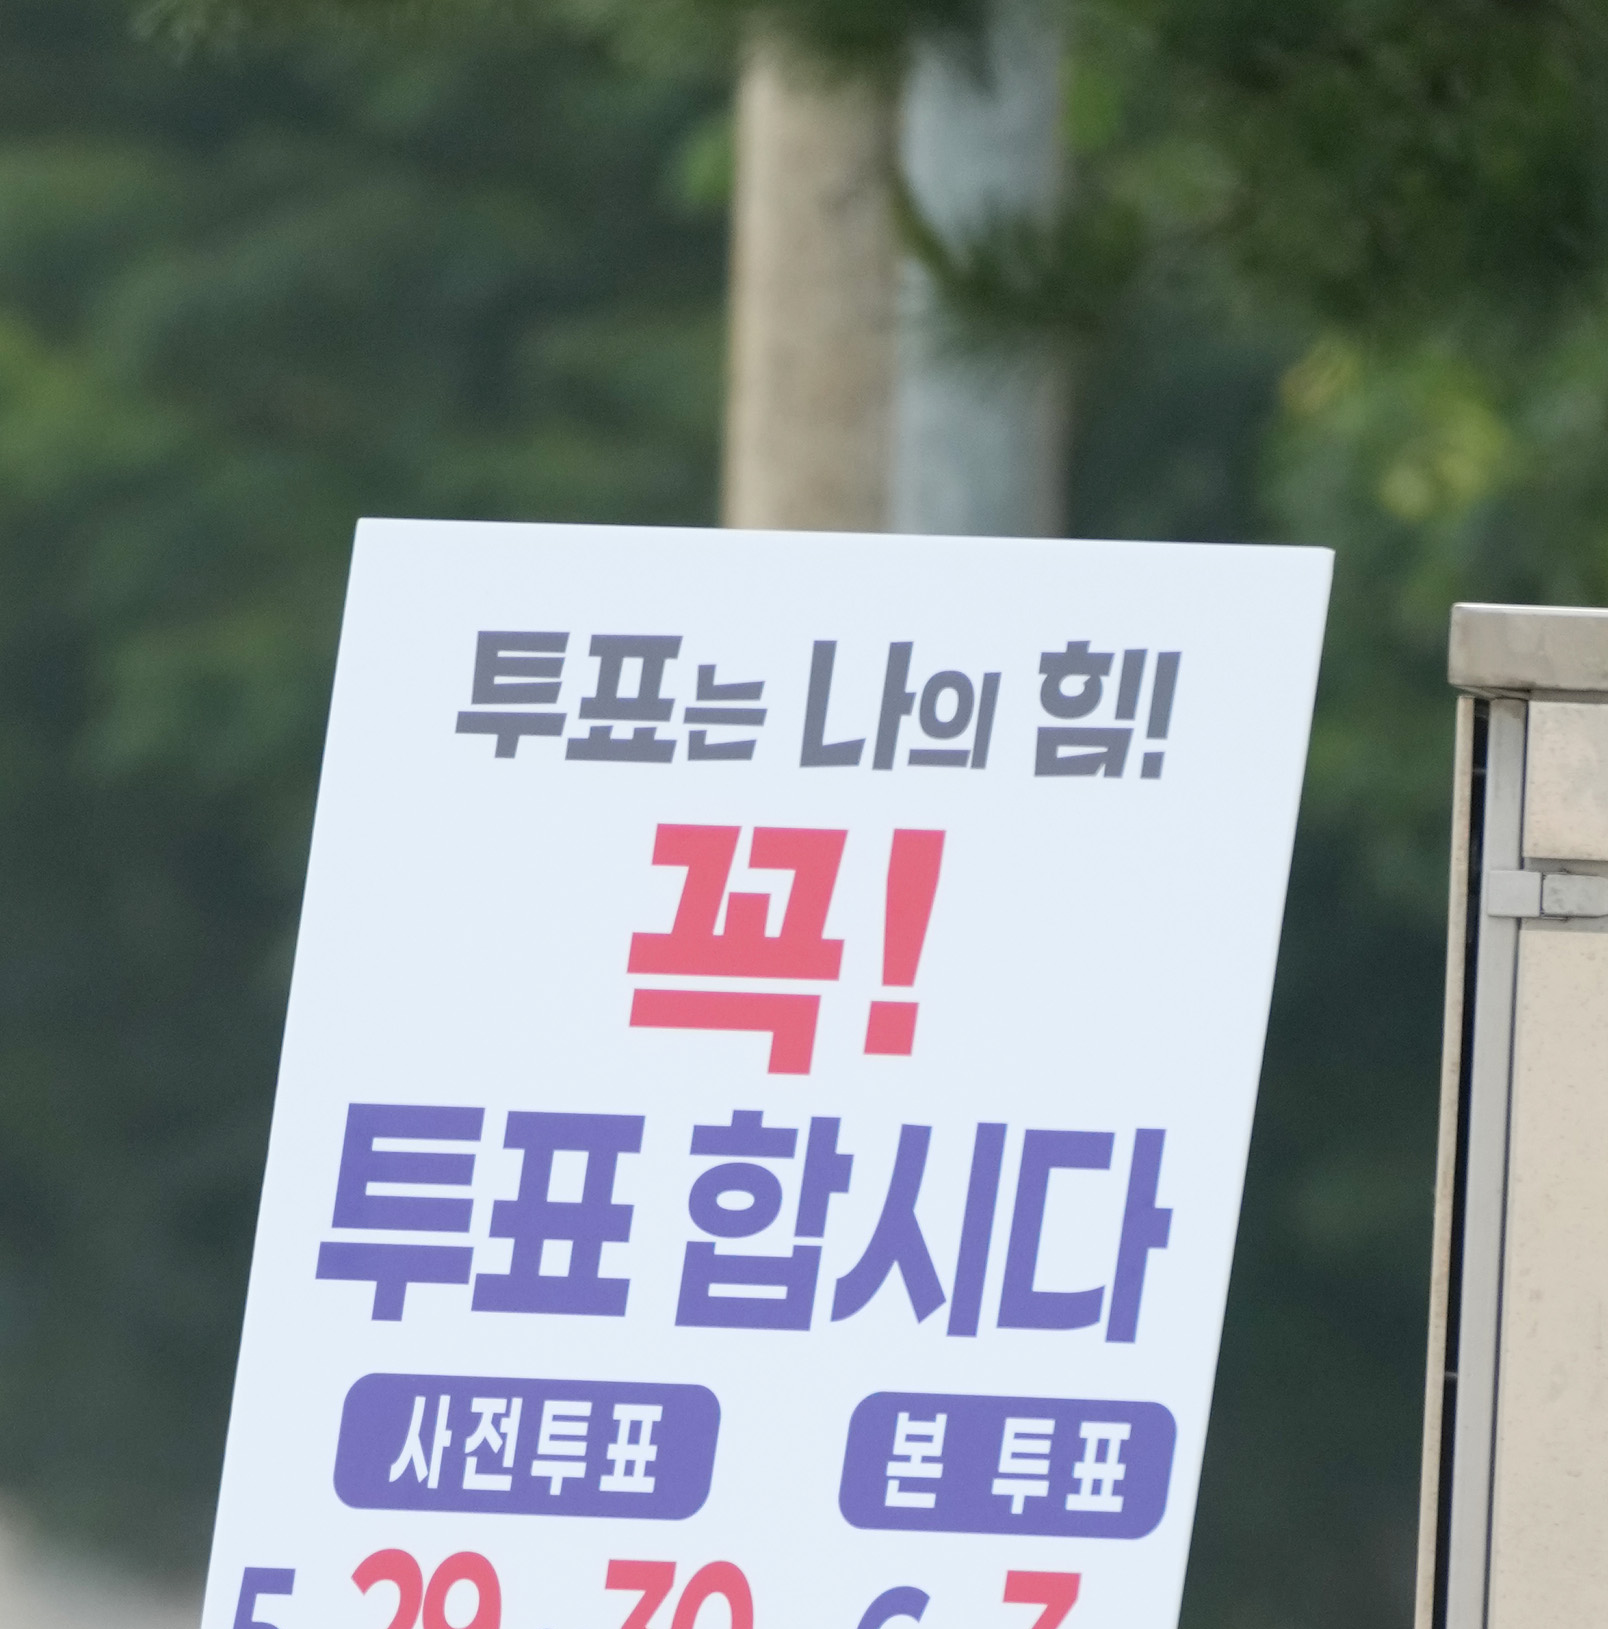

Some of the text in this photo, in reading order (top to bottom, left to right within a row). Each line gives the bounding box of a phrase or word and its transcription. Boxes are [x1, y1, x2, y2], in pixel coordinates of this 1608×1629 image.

[455, 631, 1181, 779] 투표는 나의 힘!
[627, 823, 946, 1075] 꼭!
[315, 1103, 1173, 1343] 투표 합시다
[389, 1395, 663, 1495] 사전투표
[885, 1412, 1131, 1514] 본 투표
